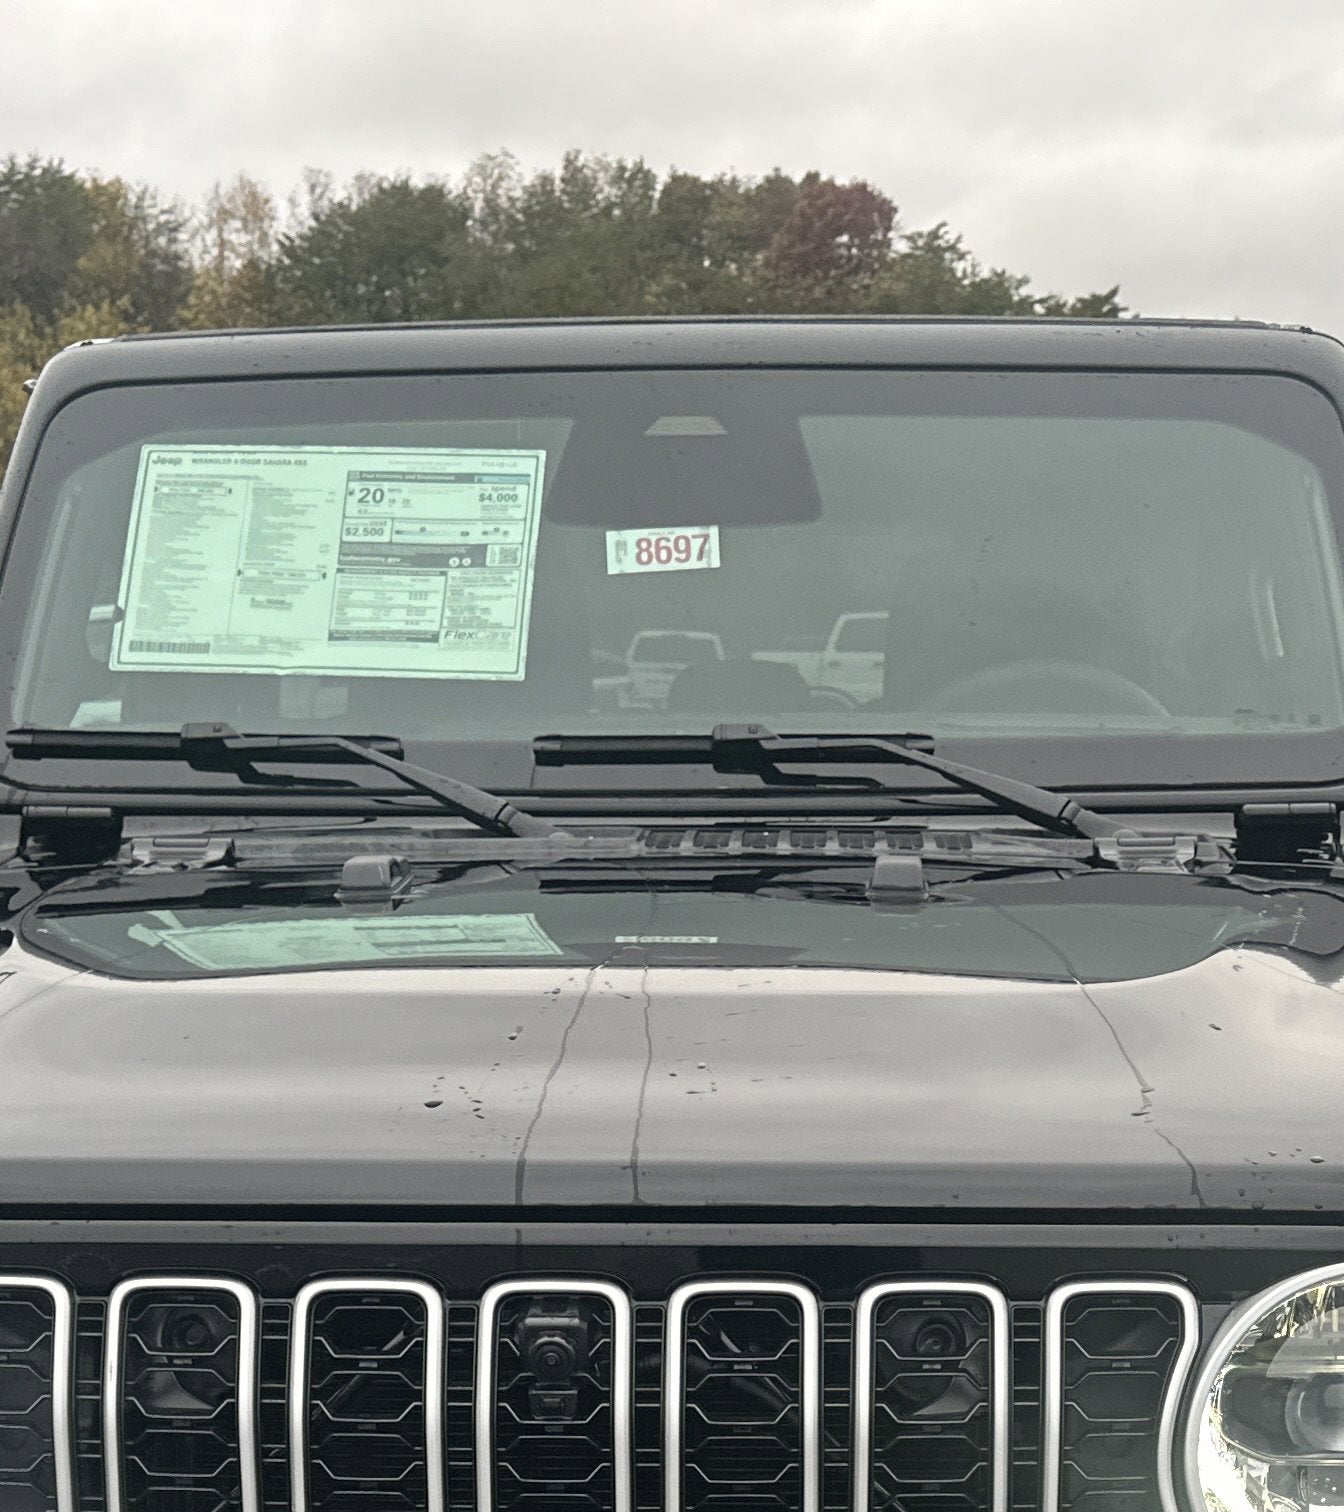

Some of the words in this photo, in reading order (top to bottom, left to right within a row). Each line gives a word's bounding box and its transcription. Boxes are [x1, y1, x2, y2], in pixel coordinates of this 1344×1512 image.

[152, 456, 183, 467] Jeep
[191, 457, 232, 465] WRANGLER
[262, 458, 293, 466] SAHARA
[491, 485, 517, 493] spend
[357, 487, 385, 504] 20
[478, 493, 519, 503] $4,000
[345, 527, 385, 537] $2,500
[635, 533, 709, 566] 8697
